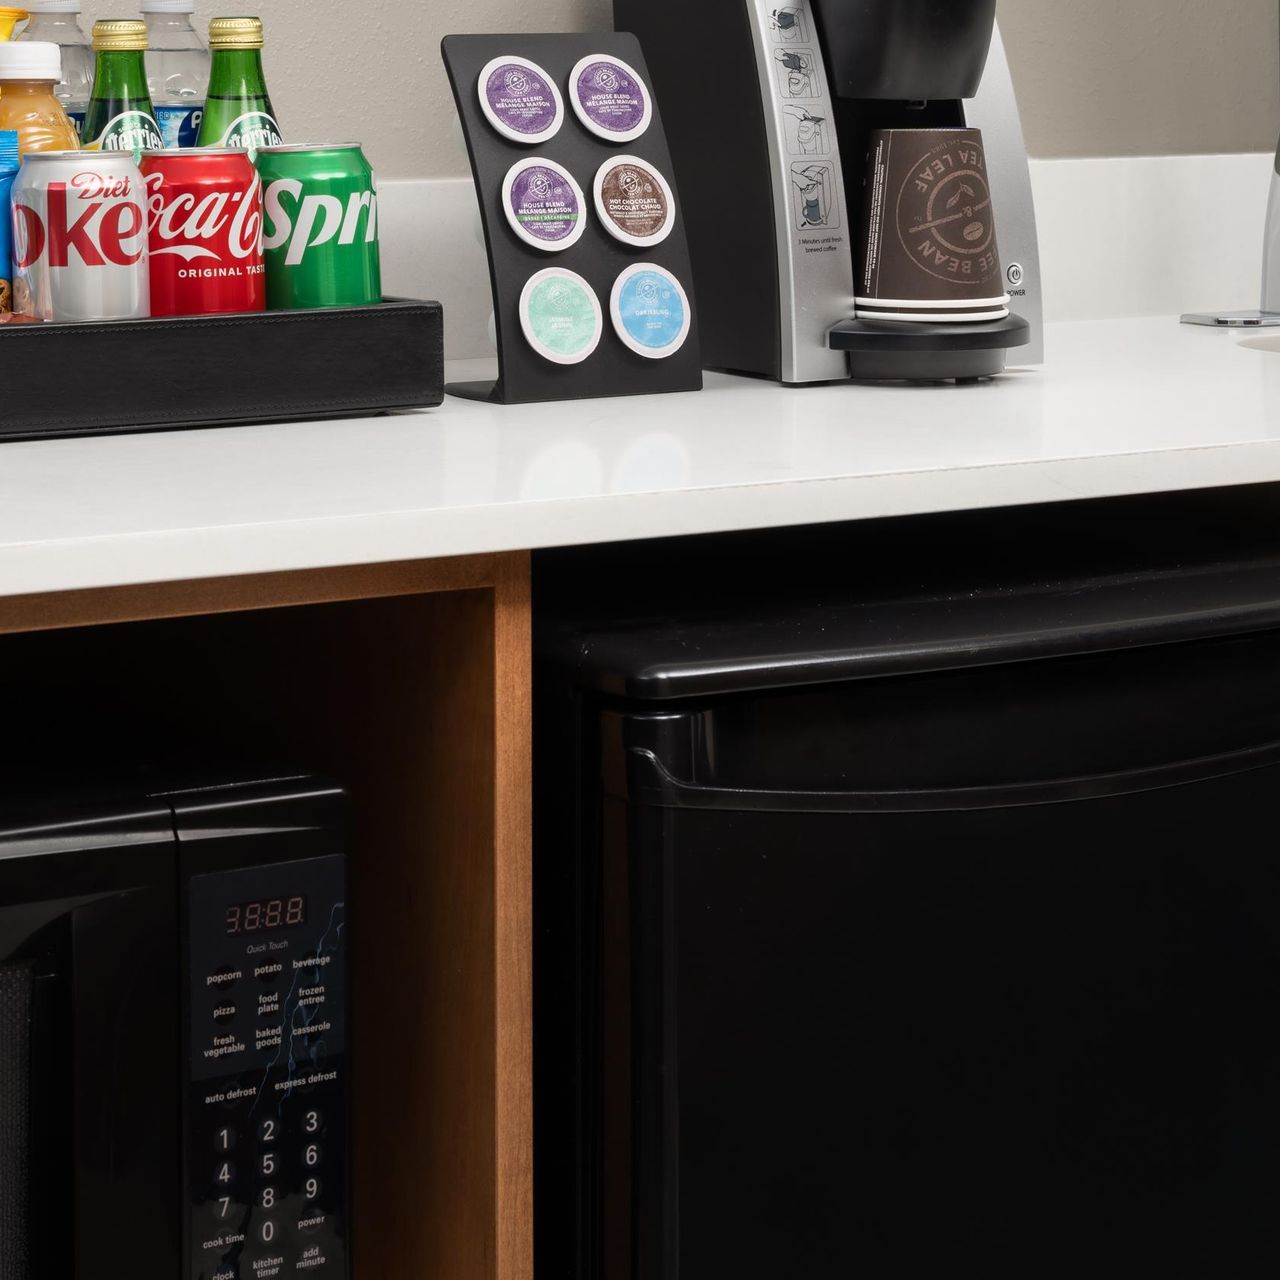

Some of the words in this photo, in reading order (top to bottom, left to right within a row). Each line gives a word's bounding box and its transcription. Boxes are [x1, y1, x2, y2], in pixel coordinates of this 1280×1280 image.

[915, 154, 953, 193] LEAF
[71, 172, 131, 199] Diet
[917, 240, 972, 273] BEAN
[178, 268, 243, 278] ORIGINAL
[247, 943, 266, 954] Quick
[269, 940, 288, 951] Touch
[293, 955, 331, 969] beverage
[255, 963, 282, 976] potato
[207, 970, 242, 985] popcorn
[299, 985, 325, 996] frozen
[259, 993, 278, 1004] food
[299, 996, 325, 1006] entree
[213, 1006, 236, 1018] pizza
[258, 1003, 279, 1015] plate
[256, 1026, 282, 1038] baked
[293, 1022, 330, 1036] casserole
[213, 1035, 235, 1046] fresh
[256, 1037, 281, 1049] goods
[204, 1043, 245, 1058] vegetable
[275, 1077, 306, 1090] express
[308, 1071, 337, 1084] defrost
[205, 1093, 224, 1104] auto
[227, 1087, 256, 1099] defrost
[306, 1111, 318, 1131] 3
[263, 1120, 274, 1141] 2
[220, 1129, 228, 1149] 1
[306, 1145, 317, 1165] 6
[263, 1154, 274, 1174] 5
[219, 1163, 230, 1183] 4
[306, 1179, 317, 1199] 9
[263, 1188, 274, 1208] 8
[218, 1197, 229, 1217] 7
[298, 1216, 325, 1229] power
[262, 1221, 273, 1241] 0
[203, 1238, 223, 1249] cook
[226, 1234, 245, 1244] time
[303, 1248, 318, 1258] add
[253, 1256, 283, 1269] kitchen
[296, 1256, 325, 1269] minute
[213, 1271, 234, 1280] clock
[257, 1266, 279, 1278] timer
